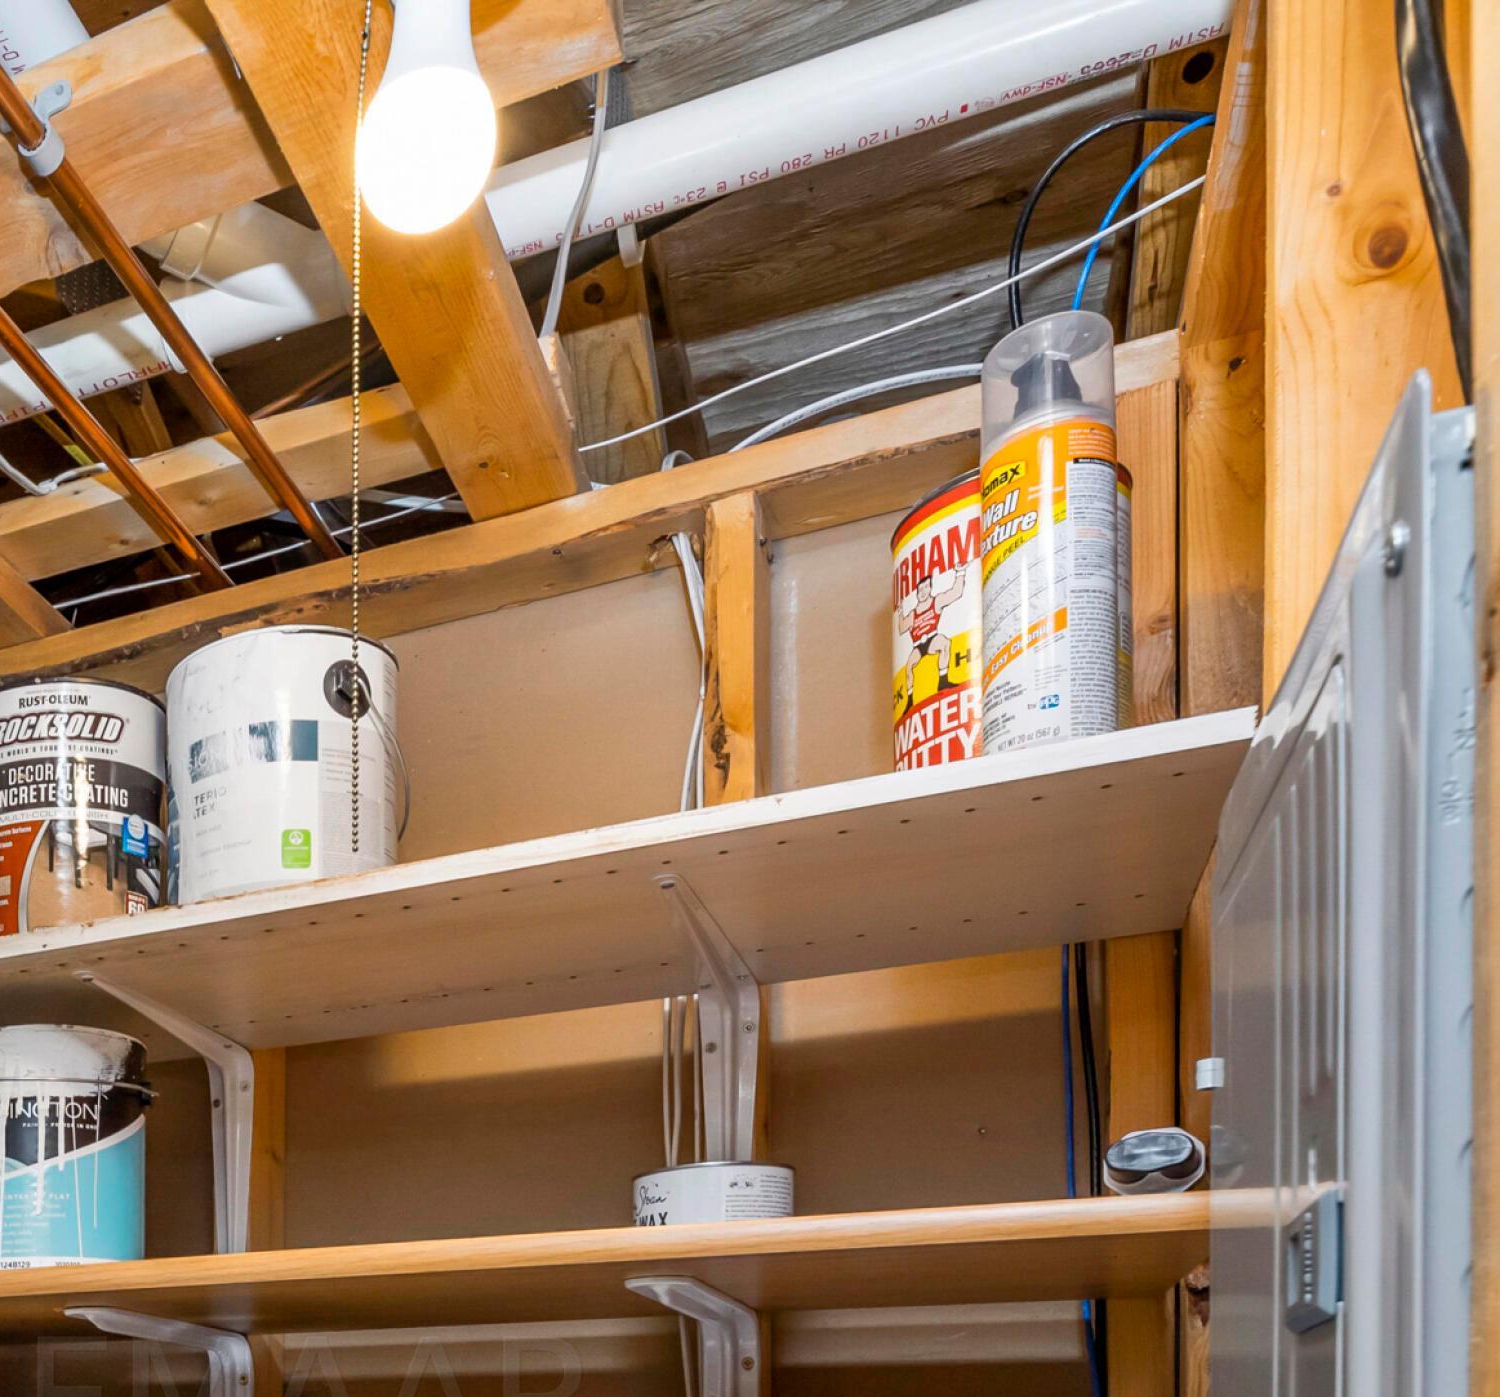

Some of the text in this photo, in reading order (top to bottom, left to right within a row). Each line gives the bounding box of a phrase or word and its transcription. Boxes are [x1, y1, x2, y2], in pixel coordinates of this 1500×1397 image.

[1169, 22, 1224, 51] ASTM
[914, 110, 949, 131] PVC
[858, 125, 900, 149] 1120
[824, 143, 846, 159] PR
[781, 153, 812, 173] 280
[740, 167, 769, 187] PSI
[624, 201, 664, 223] ASTM
[555, 216, 615, 243] D-175
[895, 686, 981, 755] WATER
